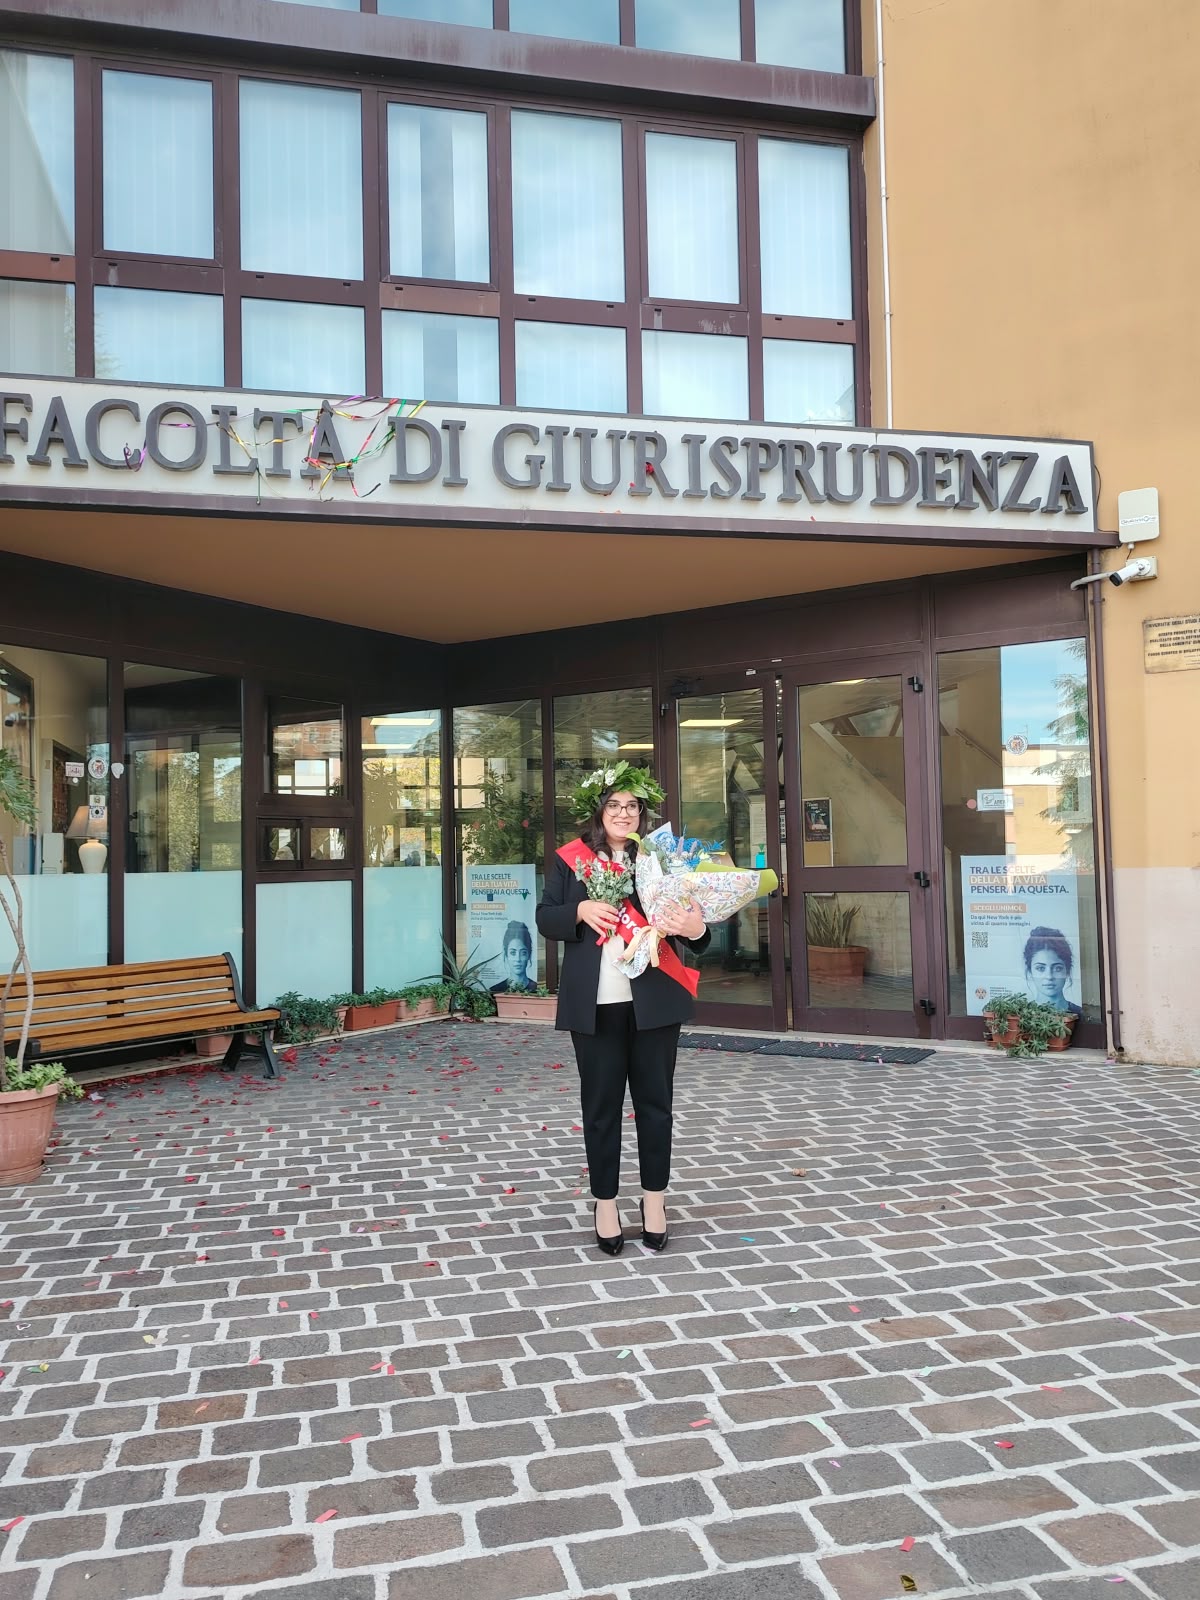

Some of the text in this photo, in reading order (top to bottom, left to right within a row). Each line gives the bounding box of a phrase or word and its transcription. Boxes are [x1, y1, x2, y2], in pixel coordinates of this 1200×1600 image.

[388, 416, 469, 488] DI
[492, 423, 1088, 516] GIURISPRUDENZA
[970, 865, 1036, 874] TRA LE SCELTE
[970, 875, 1047, 884] DELLA TUA VITA
[471, 888, 500, 896] PENSERAI
[970, 885, 1069, 895] PENSERAI A QUESTA.
